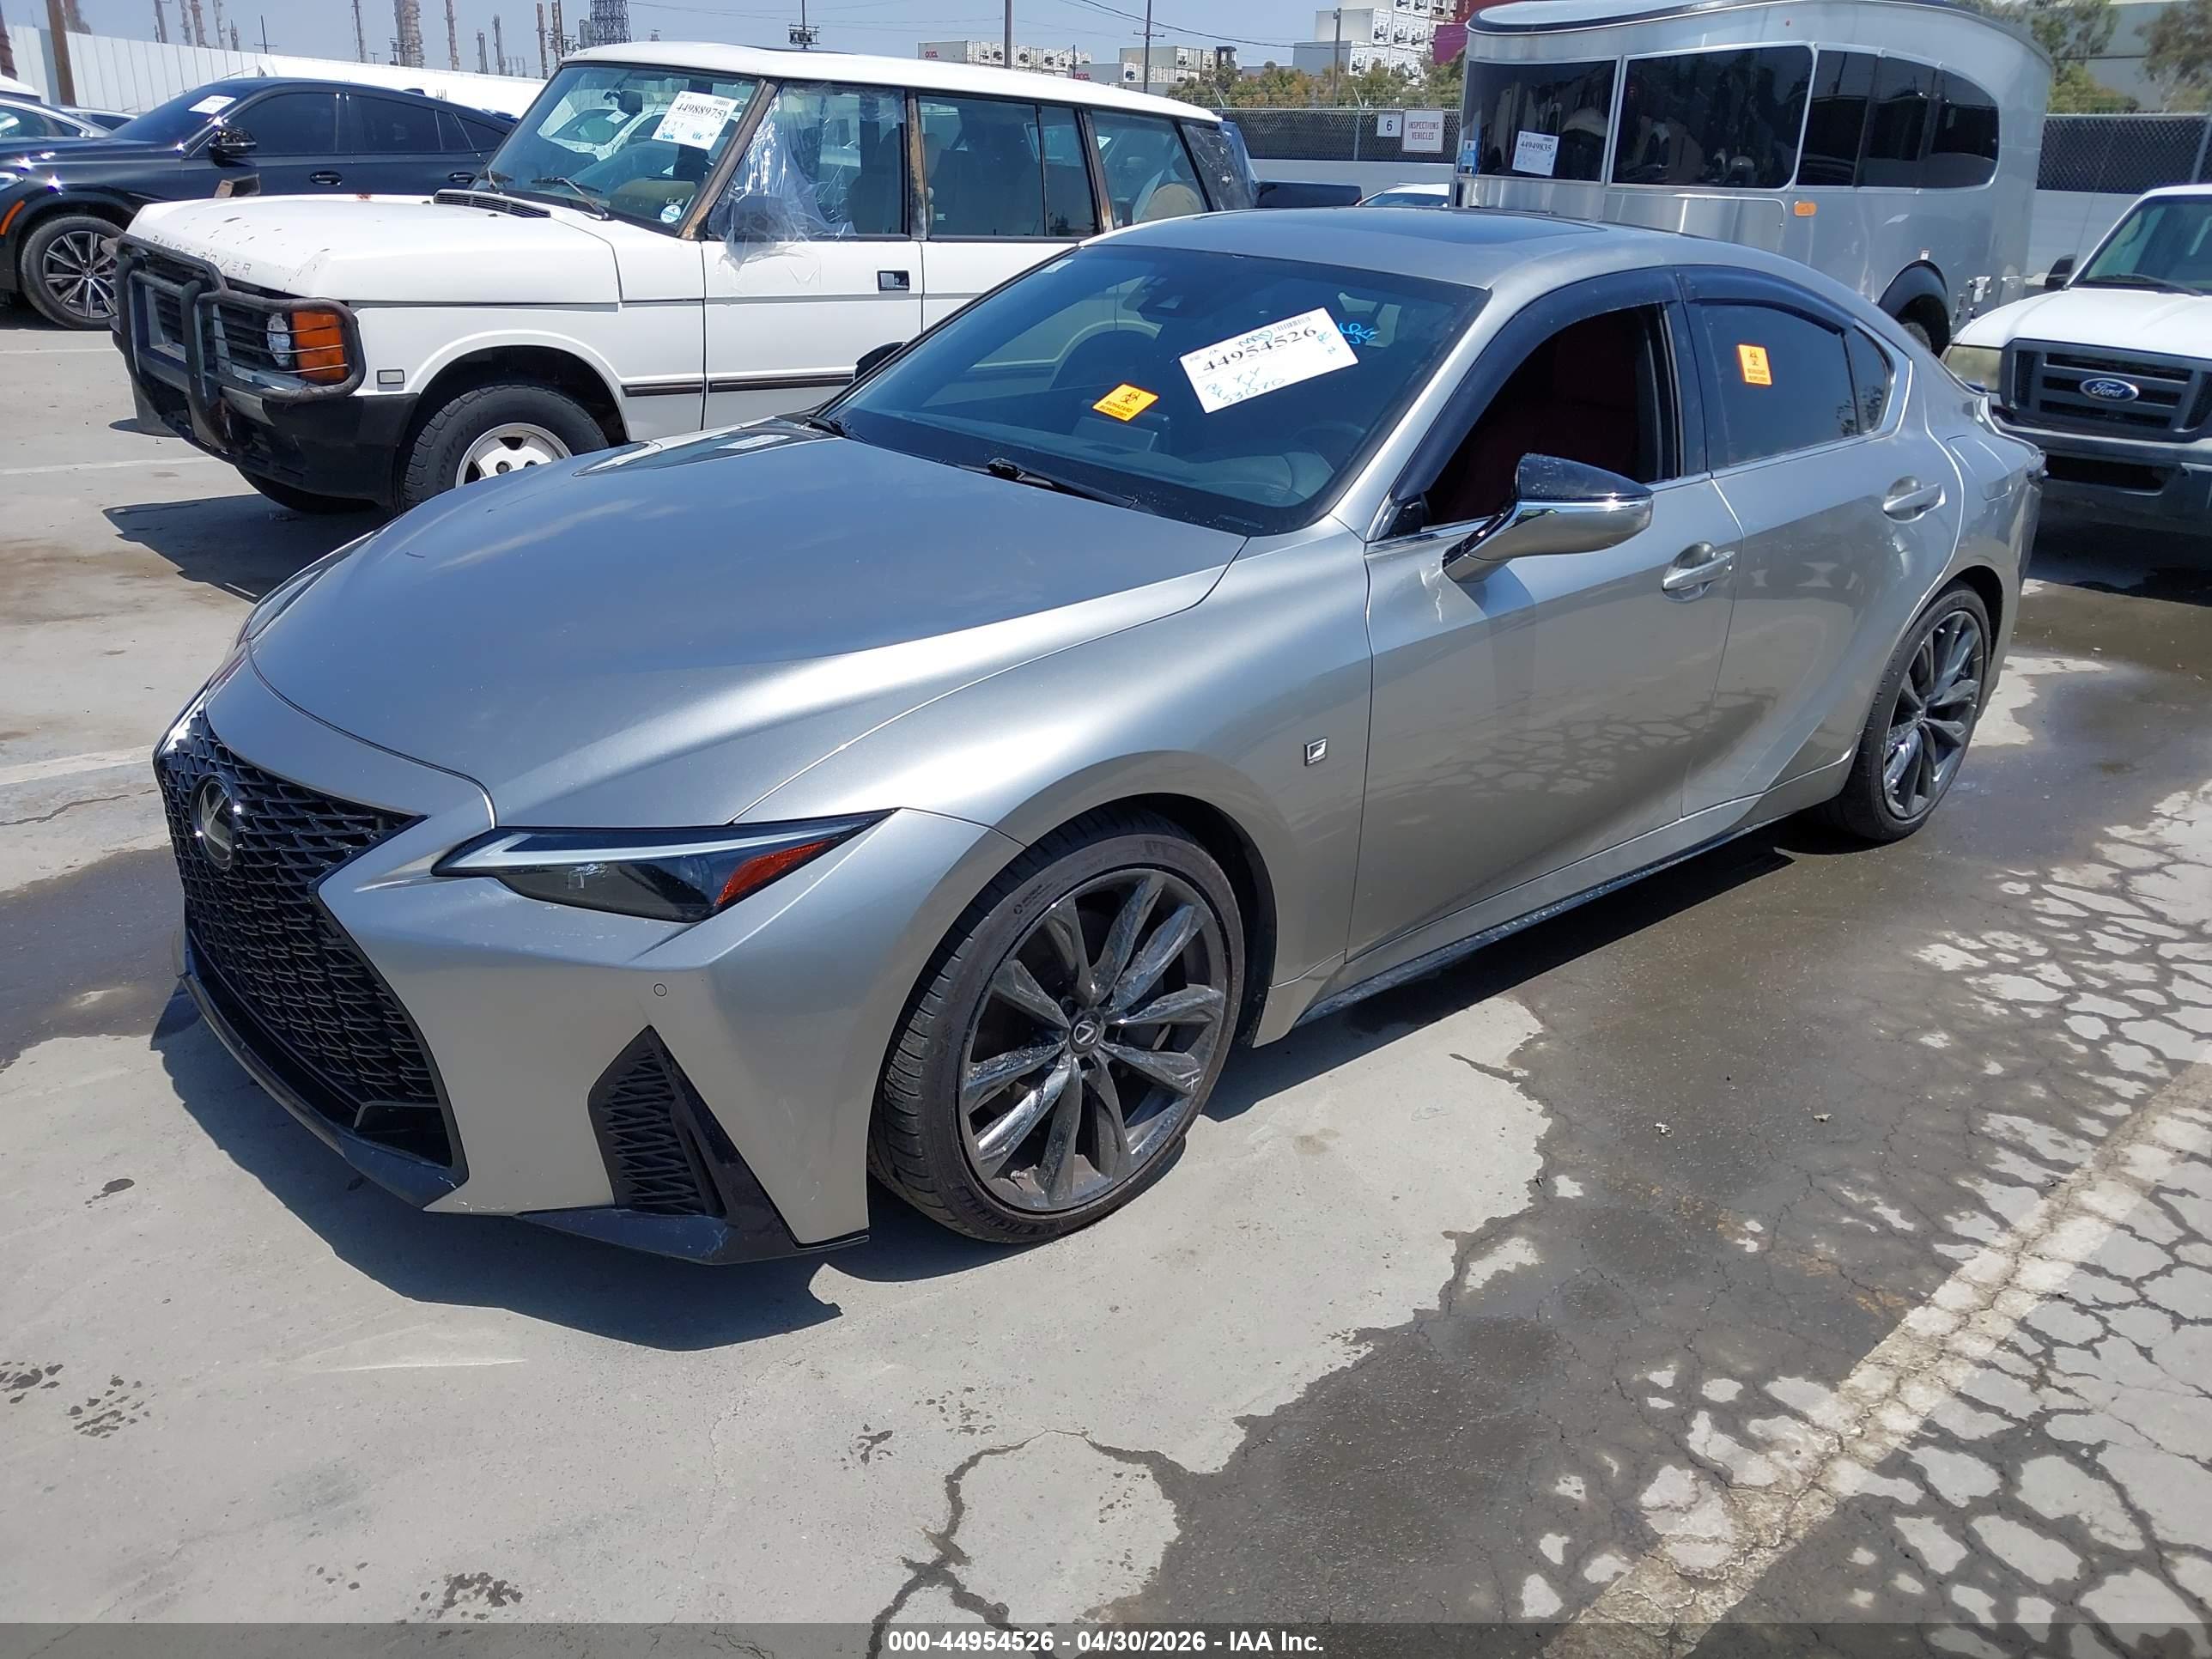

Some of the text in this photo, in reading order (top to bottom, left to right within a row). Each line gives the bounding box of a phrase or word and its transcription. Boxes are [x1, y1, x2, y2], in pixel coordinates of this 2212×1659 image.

[676, 102, 723, 119] 44988975
[1386, 119, 1393, 131] 6
[1408, 121, 1439, 130] INSPECTIONS
[1412, 131, 1435, 140] VEHICLES
[1520, 140, 1553, 151] 44949835
[1203, 325, 1318, 372] 44954526
[2091, 381, 2125, 398] Ford
